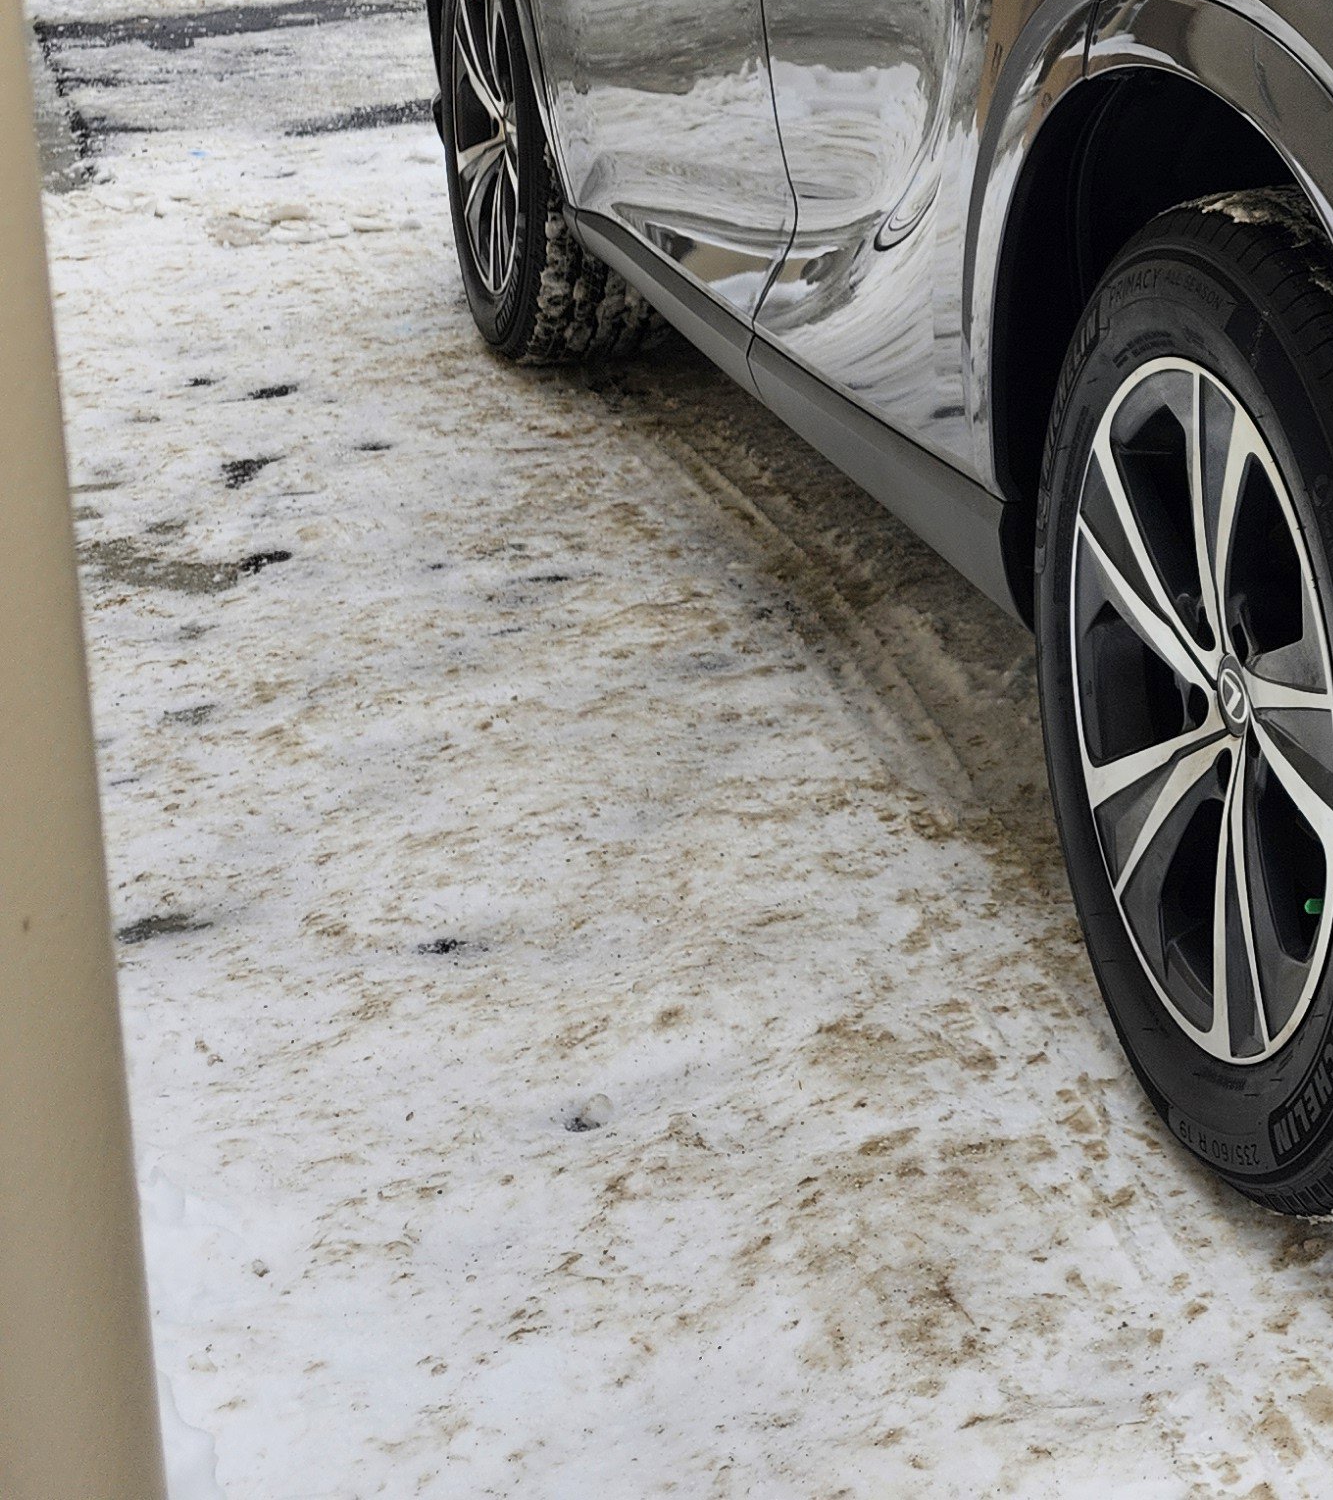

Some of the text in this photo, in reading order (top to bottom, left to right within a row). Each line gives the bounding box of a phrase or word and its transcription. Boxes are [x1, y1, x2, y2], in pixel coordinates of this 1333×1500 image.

[1179, 1120, 1261, 1167] 235/60 R 19
